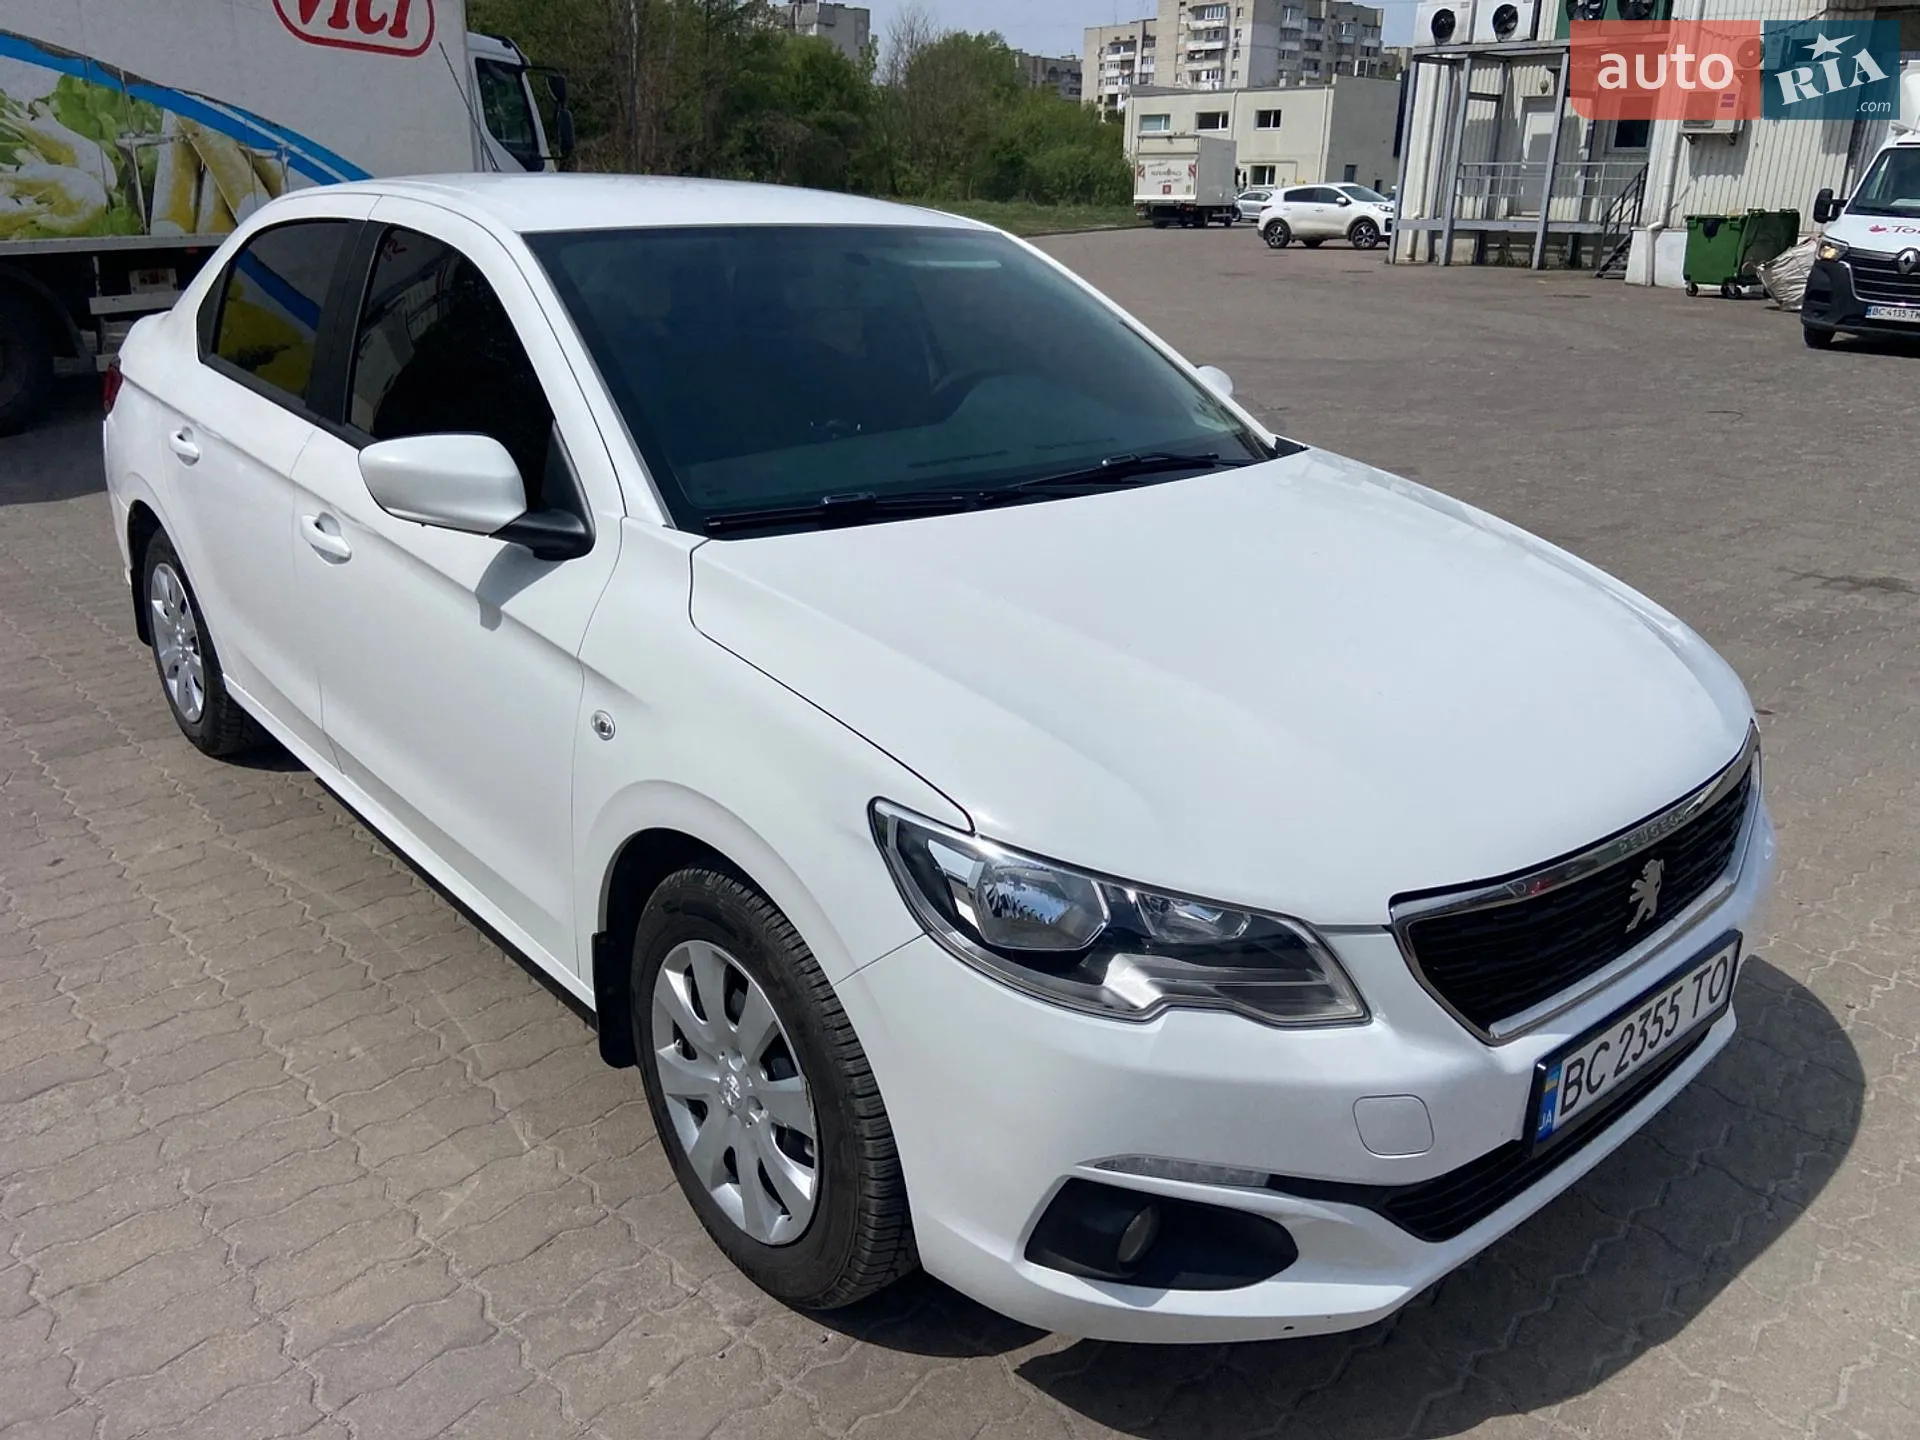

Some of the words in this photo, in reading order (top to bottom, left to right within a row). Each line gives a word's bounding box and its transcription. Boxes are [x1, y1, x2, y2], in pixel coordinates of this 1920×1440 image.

[1559, 1041, 1610, 1116] BC
[1613, 986, 1683, 1078] 2355
[1692, 955, 1728, 1018] TO
